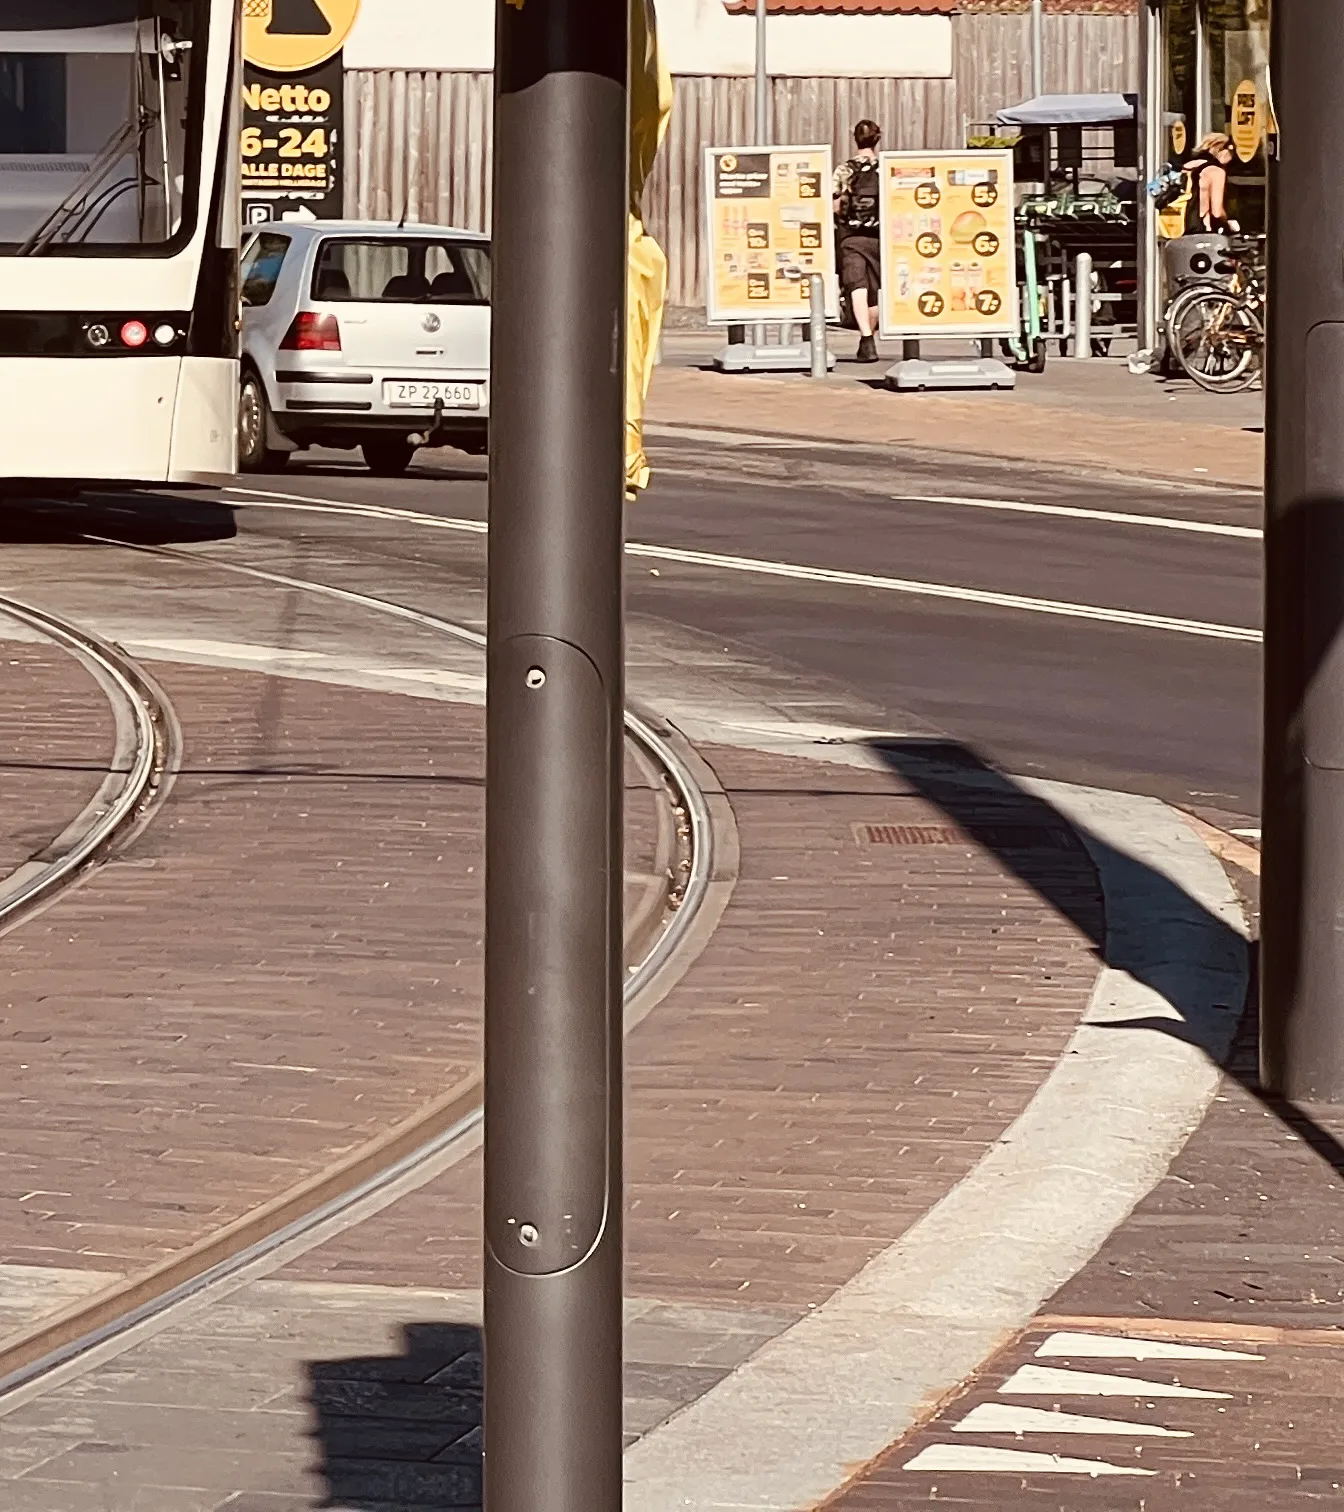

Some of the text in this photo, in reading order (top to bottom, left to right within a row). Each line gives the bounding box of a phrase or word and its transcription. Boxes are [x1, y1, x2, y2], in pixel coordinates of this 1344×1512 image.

[241, 127, 328, 158] 6-24
[281, 164, 327, 178] DAGE
[398, 386, 471, 400] ZP 22 660
